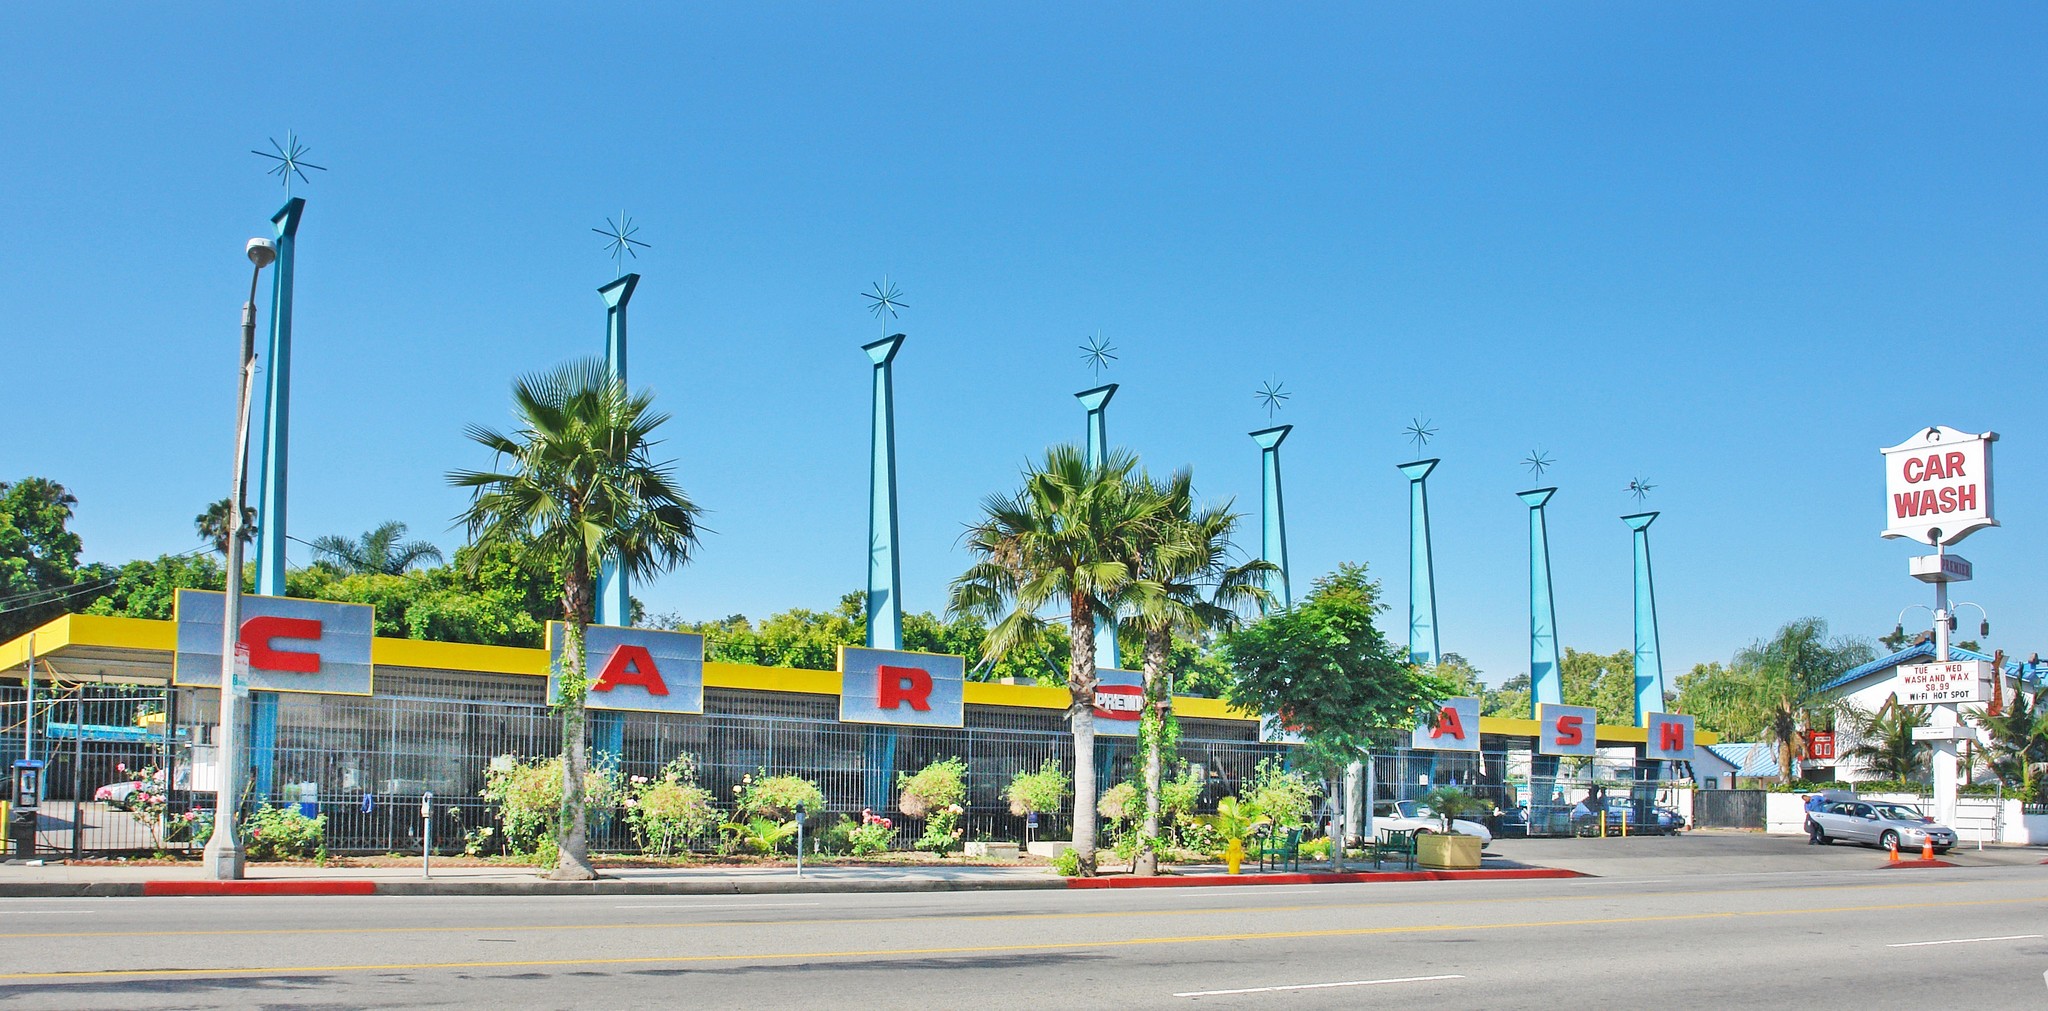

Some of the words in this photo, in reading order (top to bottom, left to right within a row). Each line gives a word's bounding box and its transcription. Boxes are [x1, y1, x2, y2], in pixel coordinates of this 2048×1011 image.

[1903, 451, 1966, 484] CAR
[1894, 484, 1977, 518] WASH
[1941, 558, 1969, 577] PREMIER
[240, 615, 322, 673] C
[591, 644, 669, 696] A
[1905, 675, 1927, 683] WASH
[1929, 674, 1946, 682] AND
[1950, 673, 1969, 681] WAX
[1914, 666, 1928, 674] TUE
[1945, 664, 1962, 672] WED
[877, 664, 932, 711] R
[1925, 683, 1950, 691] $8.99
[1933, 691, 1948, 699] HOT
[1951, 690, 1969, 698] SPOT
[1430, 706, 1466, 740] A
[1556, 715, 1583, 745] S
[1660, 722, 1684, 751] H
